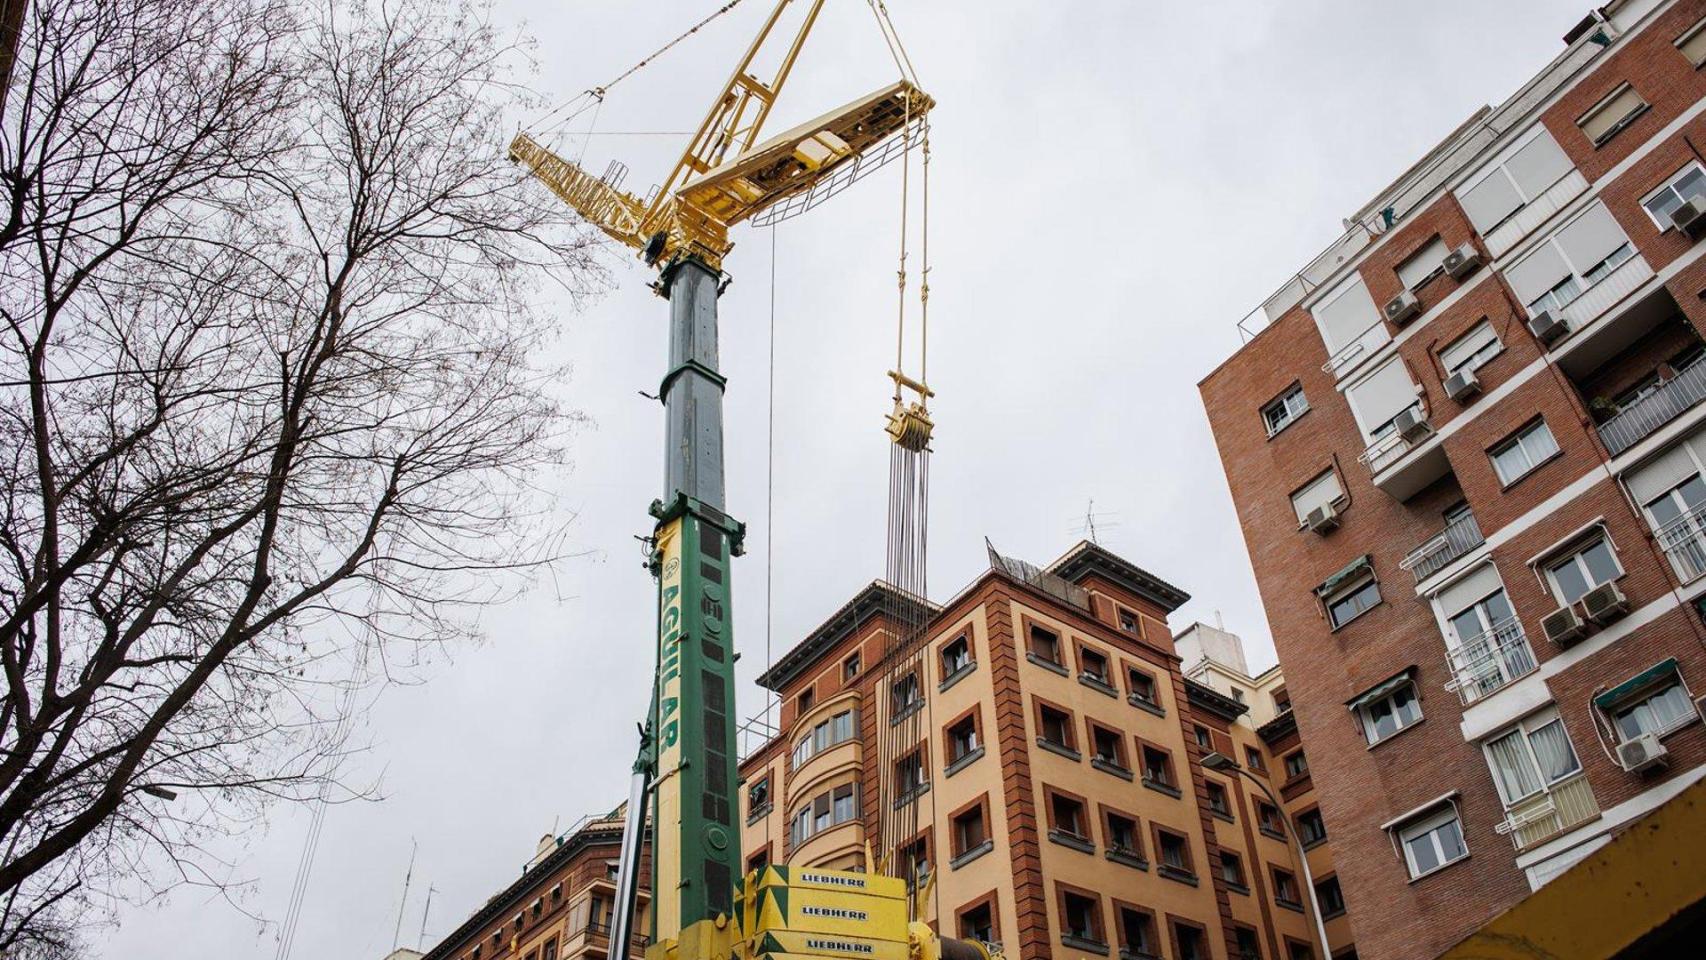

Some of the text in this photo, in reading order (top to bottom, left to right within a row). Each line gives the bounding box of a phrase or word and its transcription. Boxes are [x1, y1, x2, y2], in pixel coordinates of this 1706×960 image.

[661, 585, 679, 755] AGUILAR
[802, 874, 865, 887] LIEBHERR
[802, 907, 866, 920] LIEBHERR
[807, 940, 872, 953] LIEBHERR
